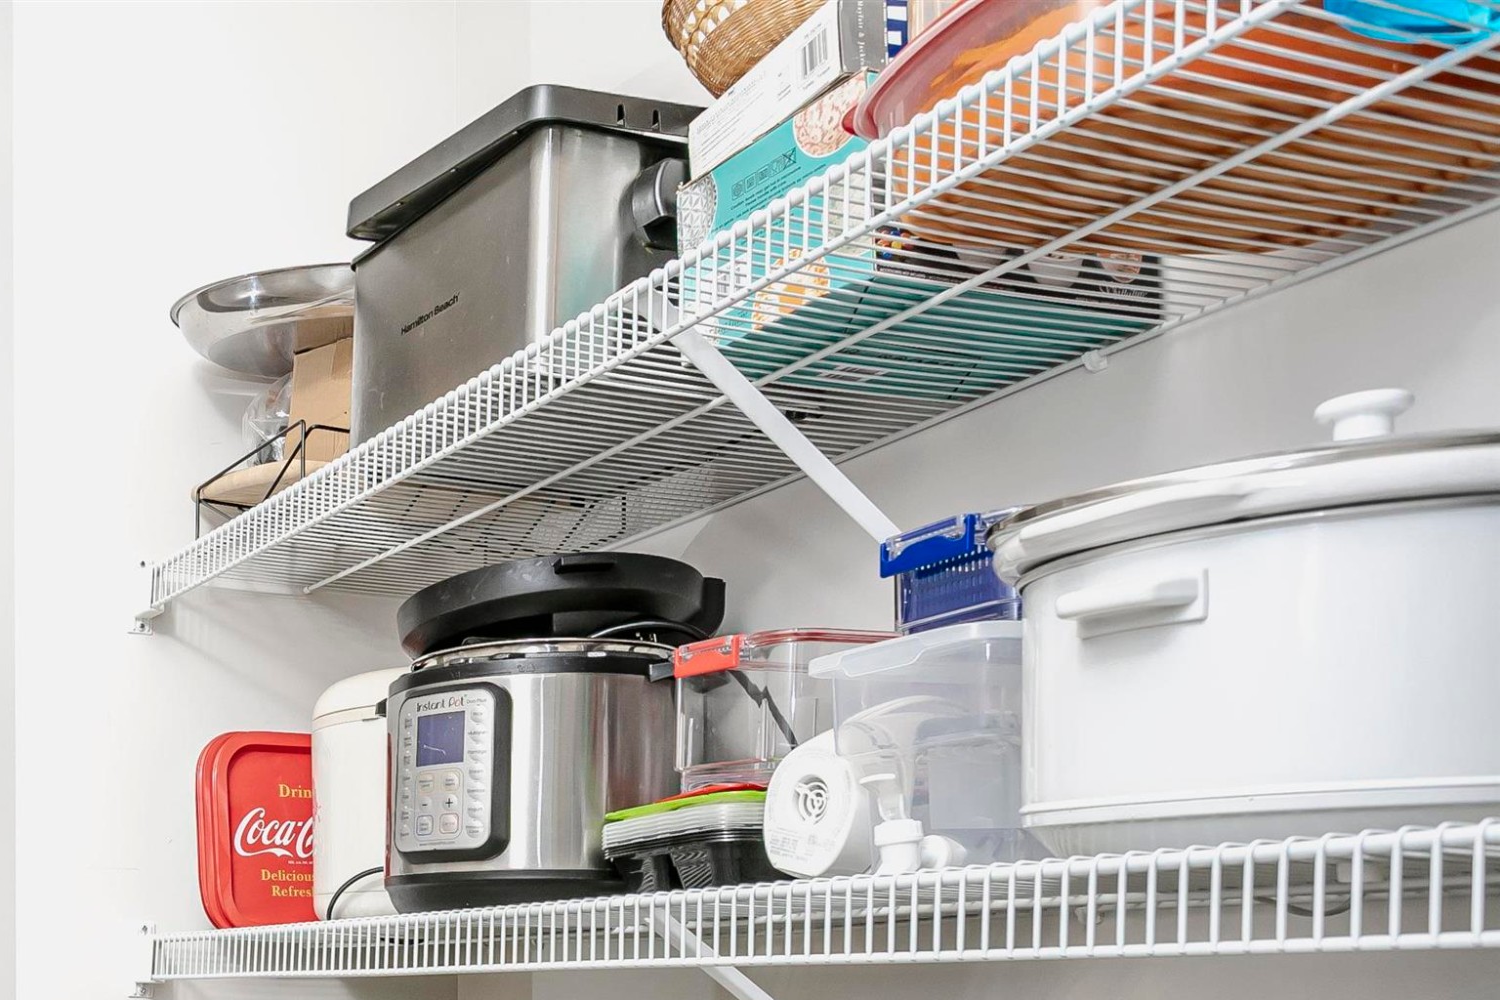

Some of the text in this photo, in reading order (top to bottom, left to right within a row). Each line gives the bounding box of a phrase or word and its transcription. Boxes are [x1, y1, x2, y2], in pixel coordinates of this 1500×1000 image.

[401, 294, 459, 336] Hamilton Beach
[416, 699, 445, 712] Instant
[449, 695, 464, 708] Pot
[279, 783, 312, 799] Drin
[233, 807, 313, 859] Coca-C
[271, 885, 313, 898] Refres
